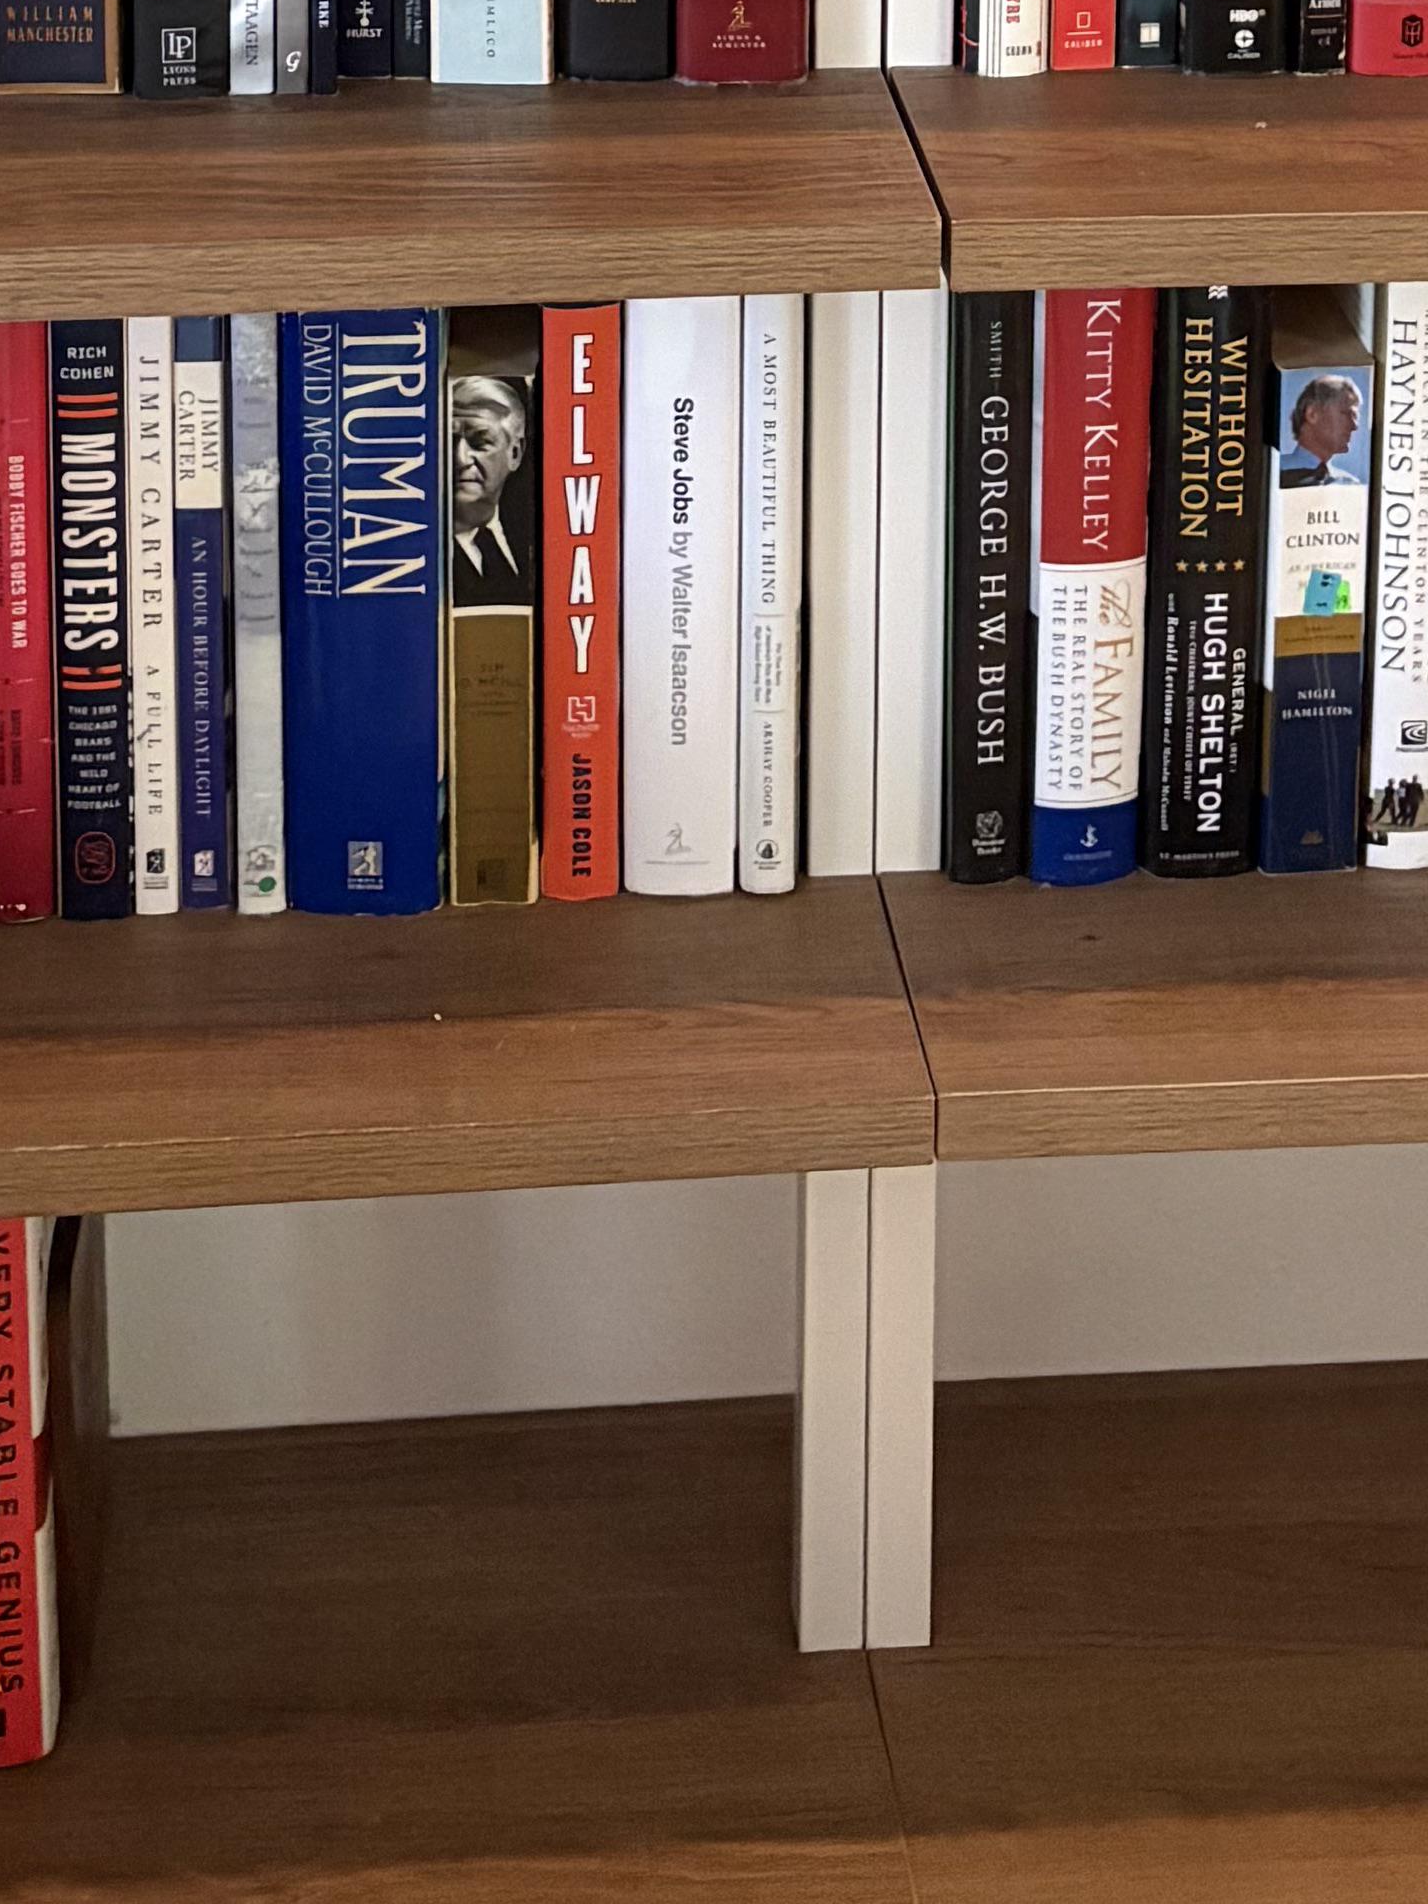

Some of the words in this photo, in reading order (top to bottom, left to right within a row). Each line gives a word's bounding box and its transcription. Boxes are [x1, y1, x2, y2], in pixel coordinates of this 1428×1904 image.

[1084, 298, 1121, 408] KITTY
[342, 321, 427, 596] TRUMAN
[673, 398, 694, 462] Steve
[1179, 317, 1214, 538] HESITATION
[1214, 336, 1248, 517] WITHOUT
[563, 333, 601, 674] ELWAY
[672, 470, 688, 524] Jobs
[1082, 421, 1118, 553] KELLEY
[1286, 531, 1360, 548] CLINTON
[1306, 511, 1340, 525] BILL
[60, 432, 120, 654] MONSTERS
[572, 753, 591, 828] JASON
[573, 836, 591, 878] COLE
